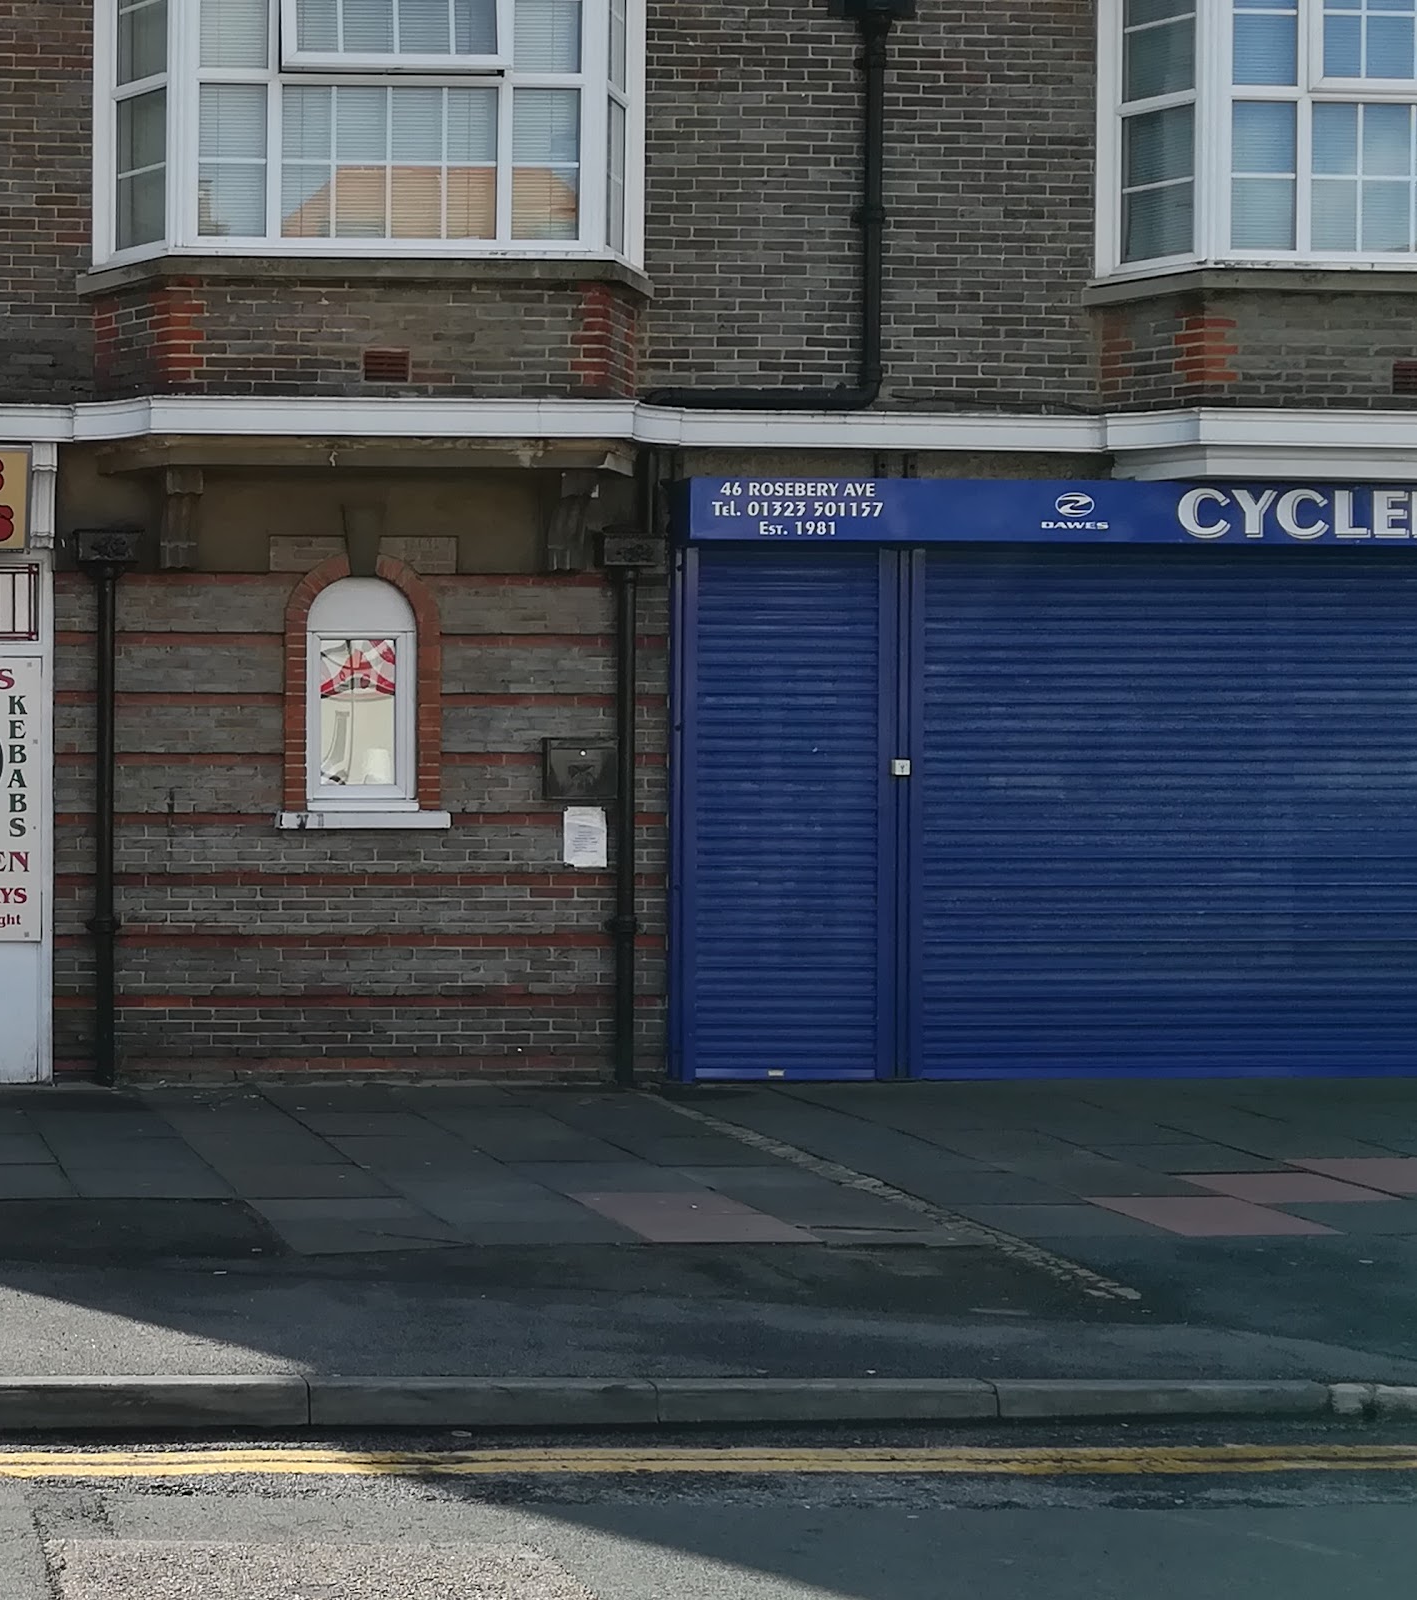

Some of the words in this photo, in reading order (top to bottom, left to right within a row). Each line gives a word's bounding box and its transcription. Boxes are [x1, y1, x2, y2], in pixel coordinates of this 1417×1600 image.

[719, 481, 743, 497] 46
[748, 482, 839, 497] ROSEBERY
[843, 482, 876, 497] AVE
[747, 501, 807, 517] 01323
[813, 501, 884, 518] 501157
[1177, 487, 1417, 539] CYCLE
[794, 521, 836, 536] 1981
[1040, 521, 1110, 531] DAWES
[6, 695, 29, 838] KEBABS
